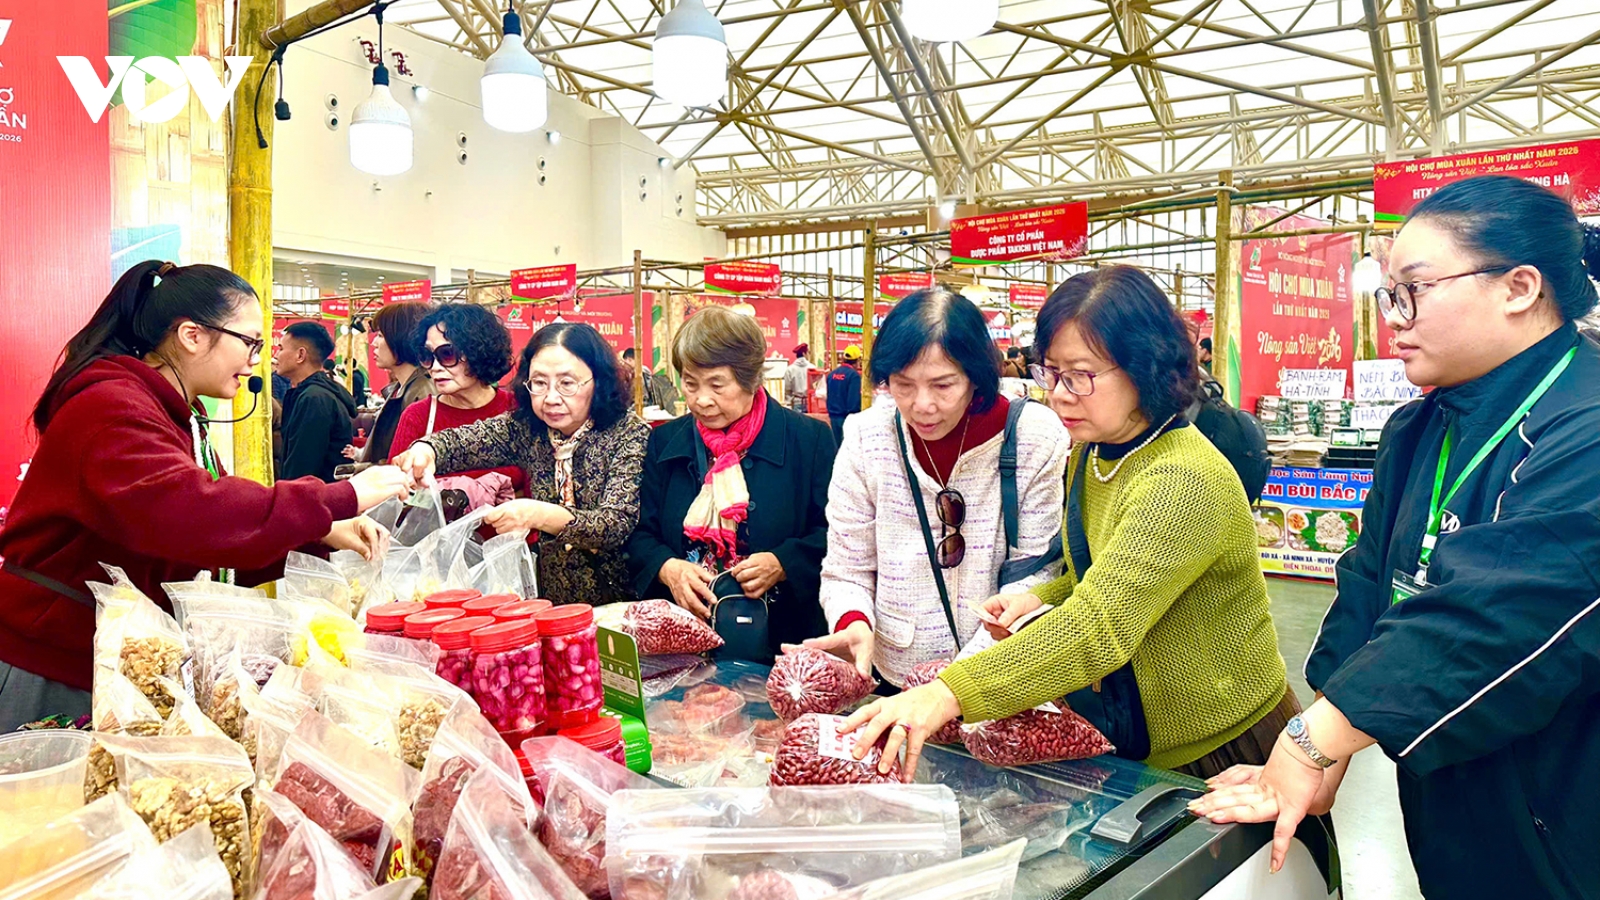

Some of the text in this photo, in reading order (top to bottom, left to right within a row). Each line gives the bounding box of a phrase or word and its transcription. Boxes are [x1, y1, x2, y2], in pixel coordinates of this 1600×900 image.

[1405, 163, 1418, 173] HỘI
[1420, 162, 1435, 171] CHỢ
[1436, 159, 1454, 169] MÙA
[1456, 156, 1477, 167] XUÂN
[1557, 146, 1579, 156] 2026
[1553, 171, 1570, 186] HÀ
[988, 234, 1006, 246] CÔNG
[1007, 234, 1016, 243] TY
[1268, 267, 1282, 298] HỘI
[1283, 273, 1298, 300] CHỢ
[1299, 273, 1315, 298] MÙA
[1315, 276, 1334, 299] XUÂN
[1257, 331, 1283, 363] Nông
[1284, 335, 1299, 355] sản
[1299, 333, 1317, 360] Việt
[1287, 482, 1316, 499] BÙI
